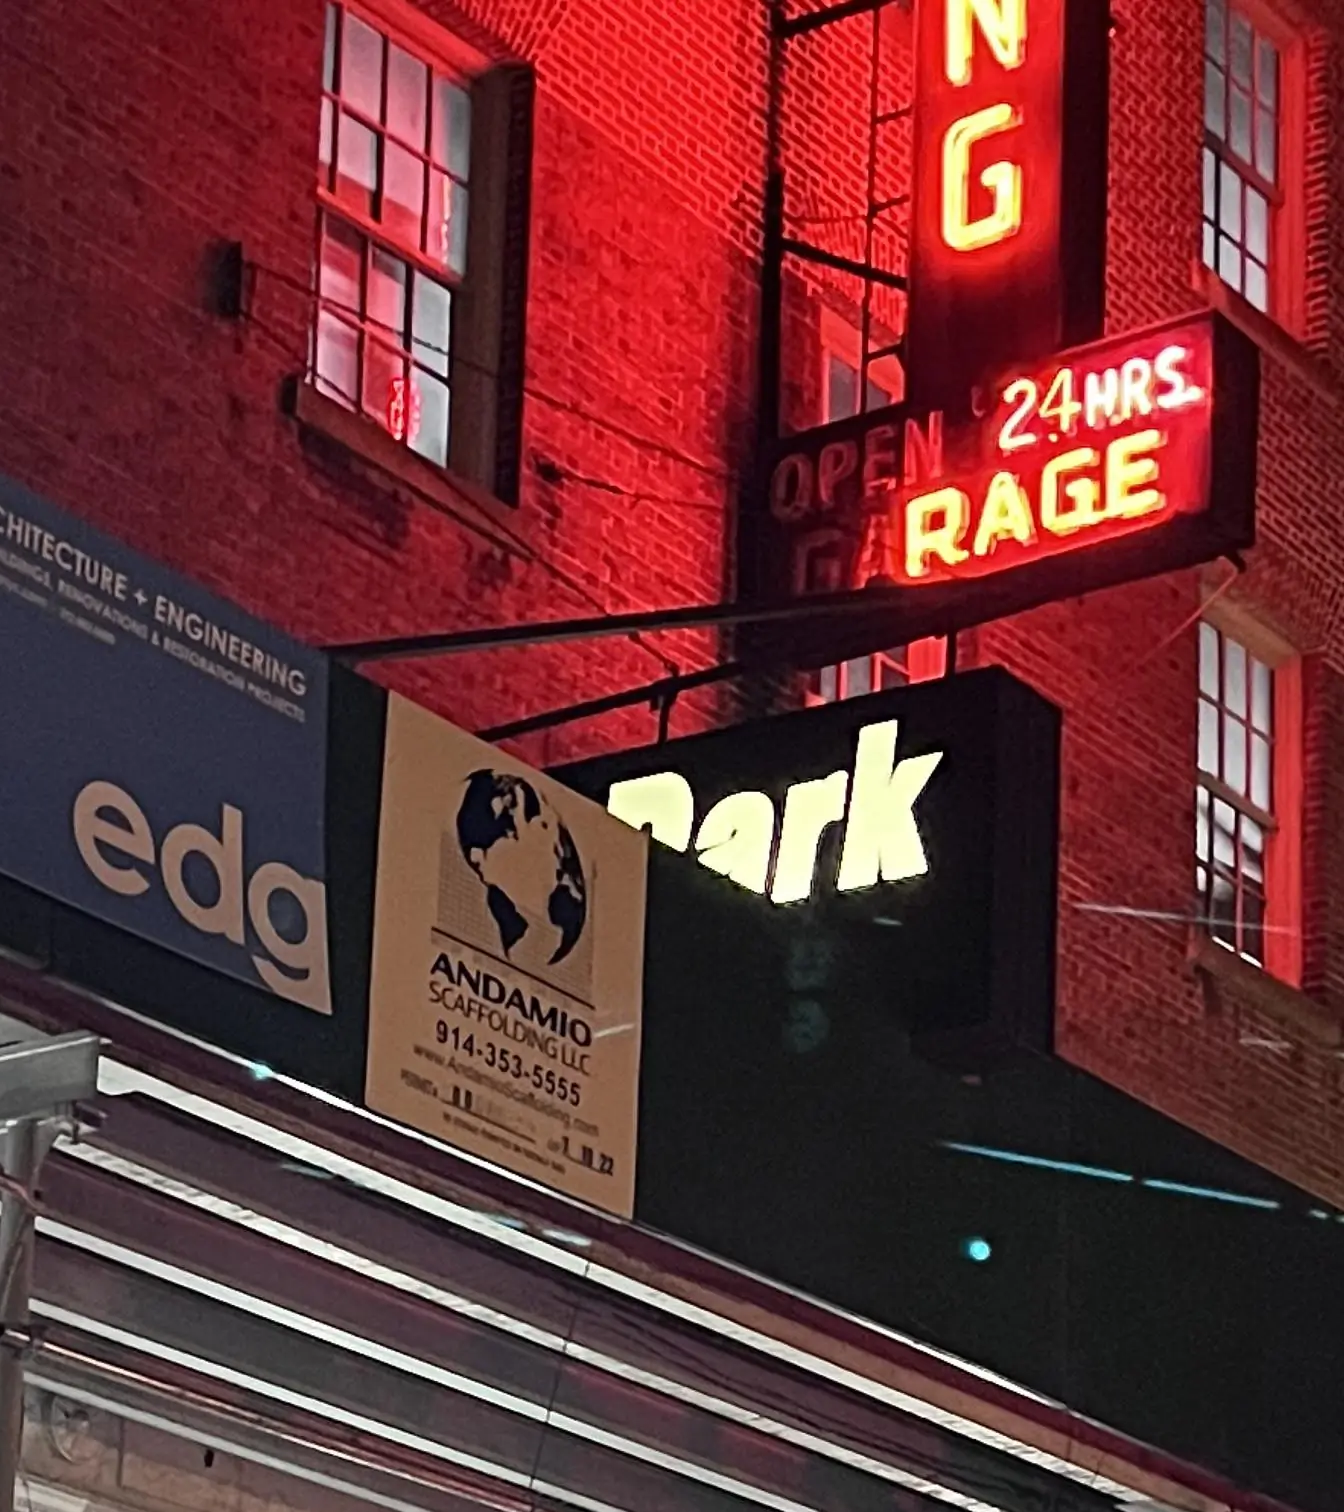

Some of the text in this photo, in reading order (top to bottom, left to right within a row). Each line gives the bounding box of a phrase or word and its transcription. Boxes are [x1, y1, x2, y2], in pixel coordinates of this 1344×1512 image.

[771, 411, 944, 520] OPEN
[155, 595, 306, 696] ENGINEERING
[73, 780, 332, 1016] edg
[428, 980, 591, 1076] SCAFFOLDING LLC
[430, 952, 592, 1047] ANDAMIO
[436, 1020, 581, 1106] 914-353-5555
